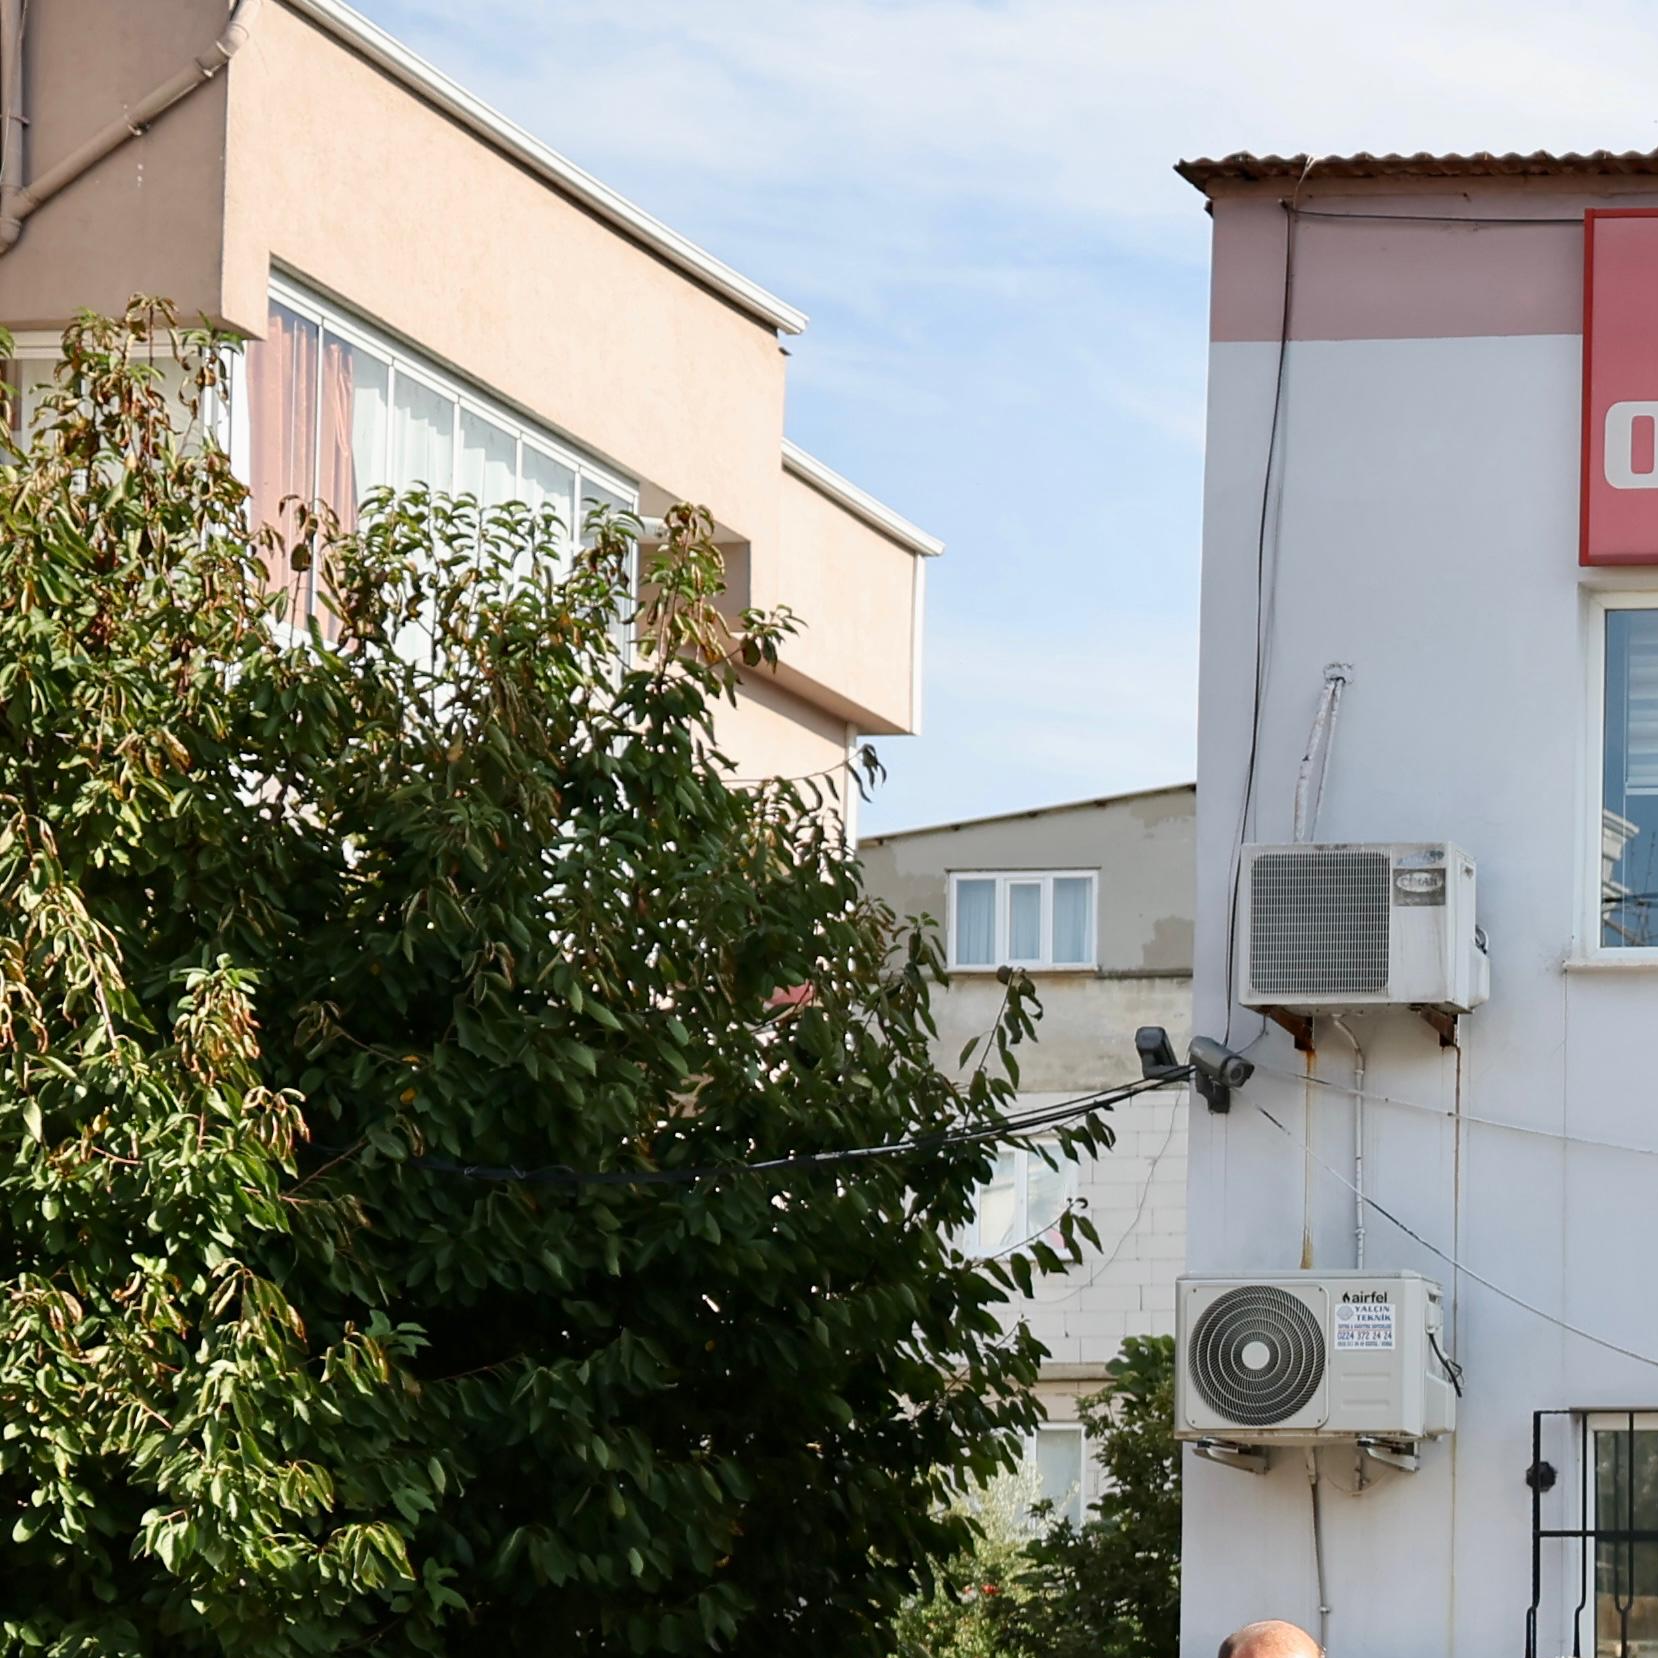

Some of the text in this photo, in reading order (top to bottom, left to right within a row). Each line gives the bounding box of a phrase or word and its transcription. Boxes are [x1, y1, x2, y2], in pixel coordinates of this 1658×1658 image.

[1352, 1290, 1387, 1303] airfel
[1337, 1331, 1354, 1340] 0224
[1373, 1331, 1381, 1340] 24
[1384, 1331, 1392, 1340] 24
